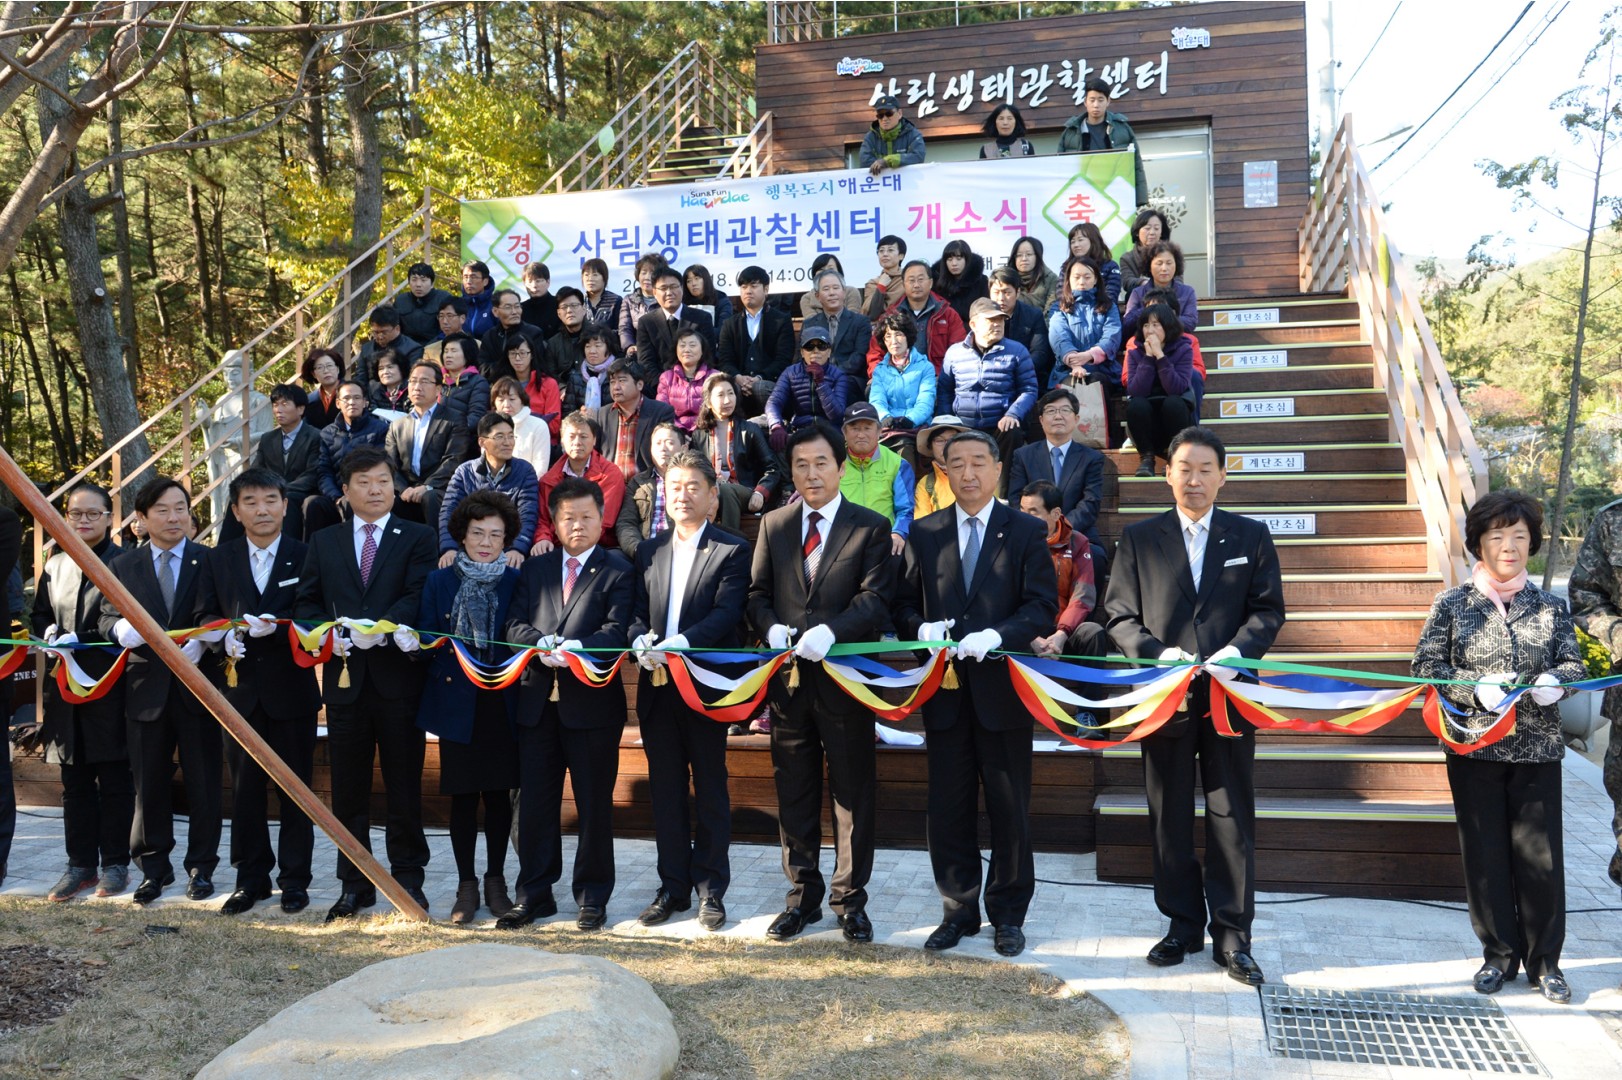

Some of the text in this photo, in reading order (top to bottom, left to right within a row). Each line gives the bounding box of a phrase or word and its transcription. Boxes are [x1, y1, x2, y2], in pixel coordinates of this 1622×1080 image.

[1173, 35, 1209, 48] 해운대
[765, 174, 902, 200] 행복도시 해운대
[690, 189, 727, 198] Sun&Fun
[1064, 193, 1095, 223] 축
[572, 197, 1028, 269] 산림생태관찰센터 개소식
[507, 233, 531, 265] 경
[1234, 312, 1272, 322] 계단조심
[1239, 354, 1279, 365] 계단조심
[1243, 402, 1286, 413] 계단조심
[1249, 457, 1295, 468] 계단조심
[1261, 519, 1306, 530] 단조심
